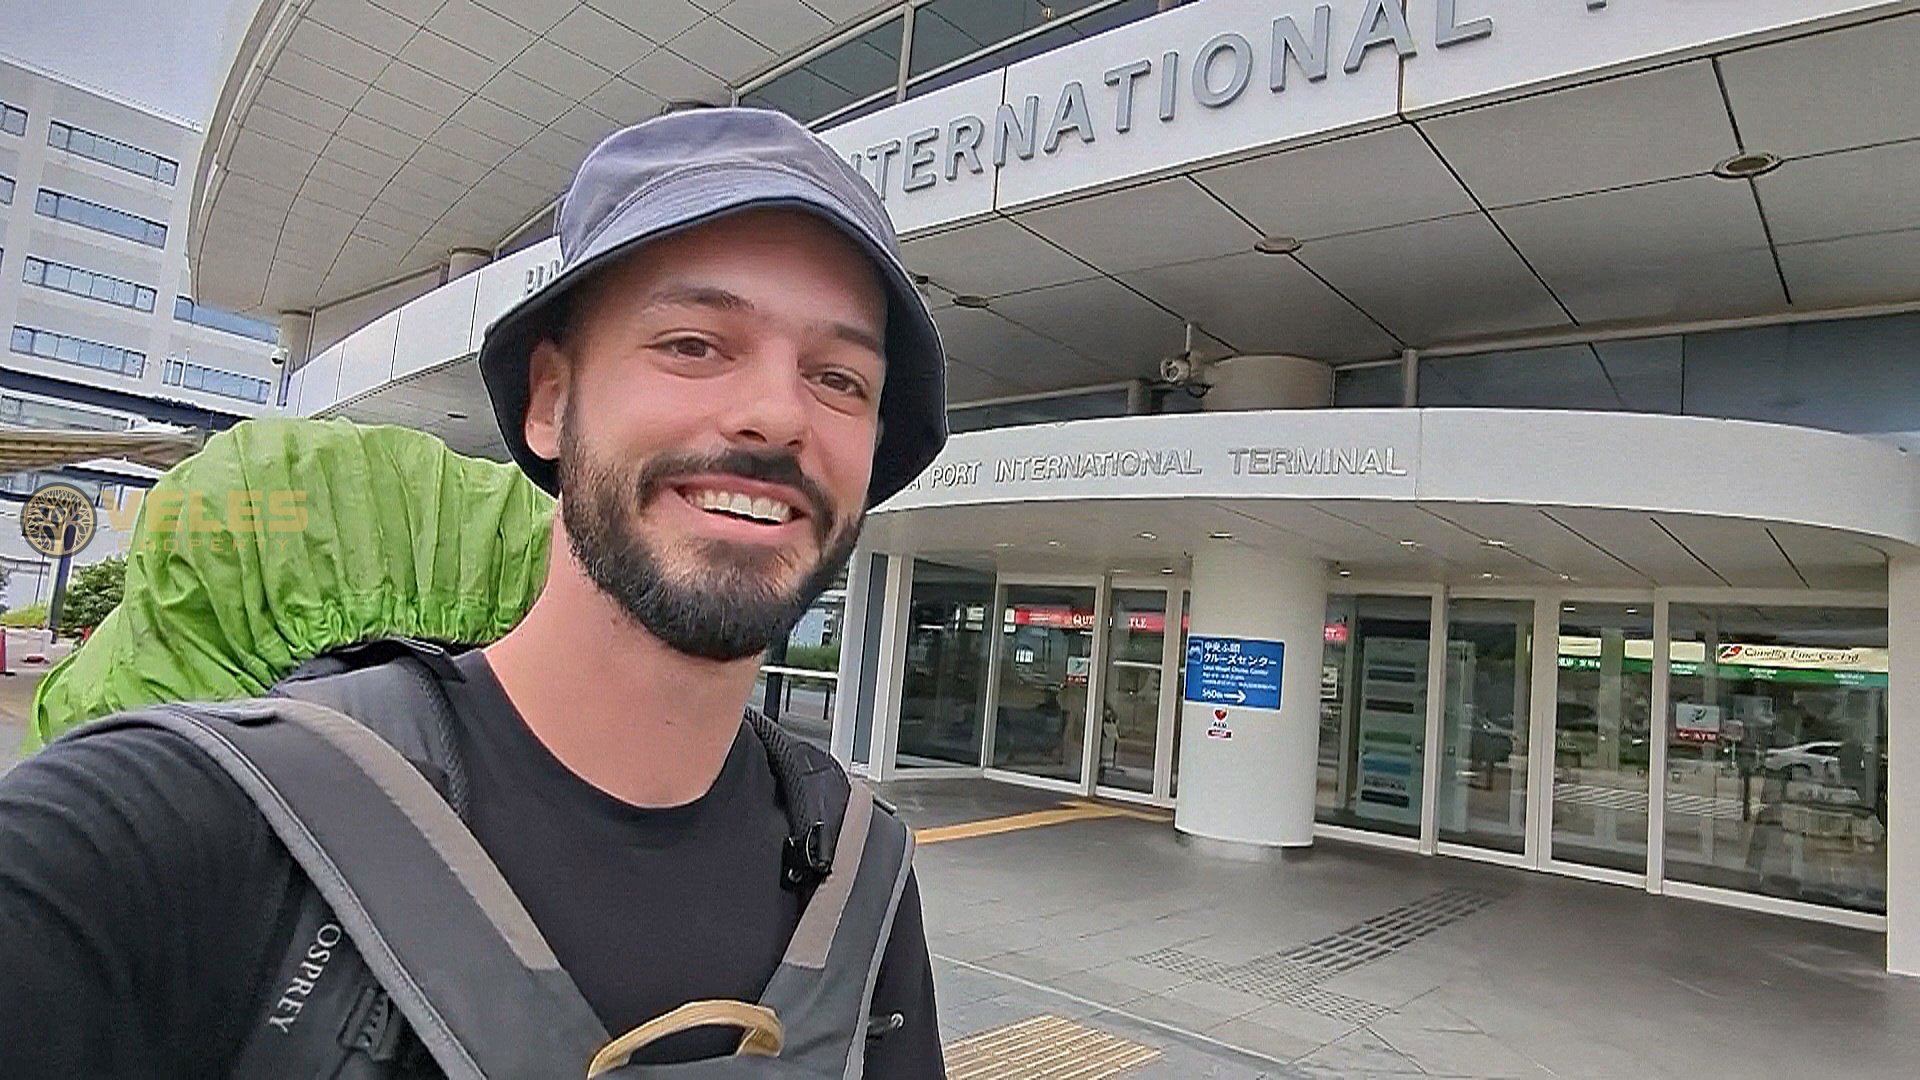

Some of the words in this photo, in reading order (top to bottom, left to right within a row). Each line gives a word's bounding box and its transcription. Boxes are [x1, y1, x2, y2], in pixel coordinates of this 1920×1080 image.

[931, 461, 982, 488] PORT
[994, 448, 1202, 483] INTERNATIONAL
[1228, 446, 1407, 476] TERMINAL
[1203, 653, 1277, 667] クルーズセンター
[269, 923, 342, 1034] OSPREY
